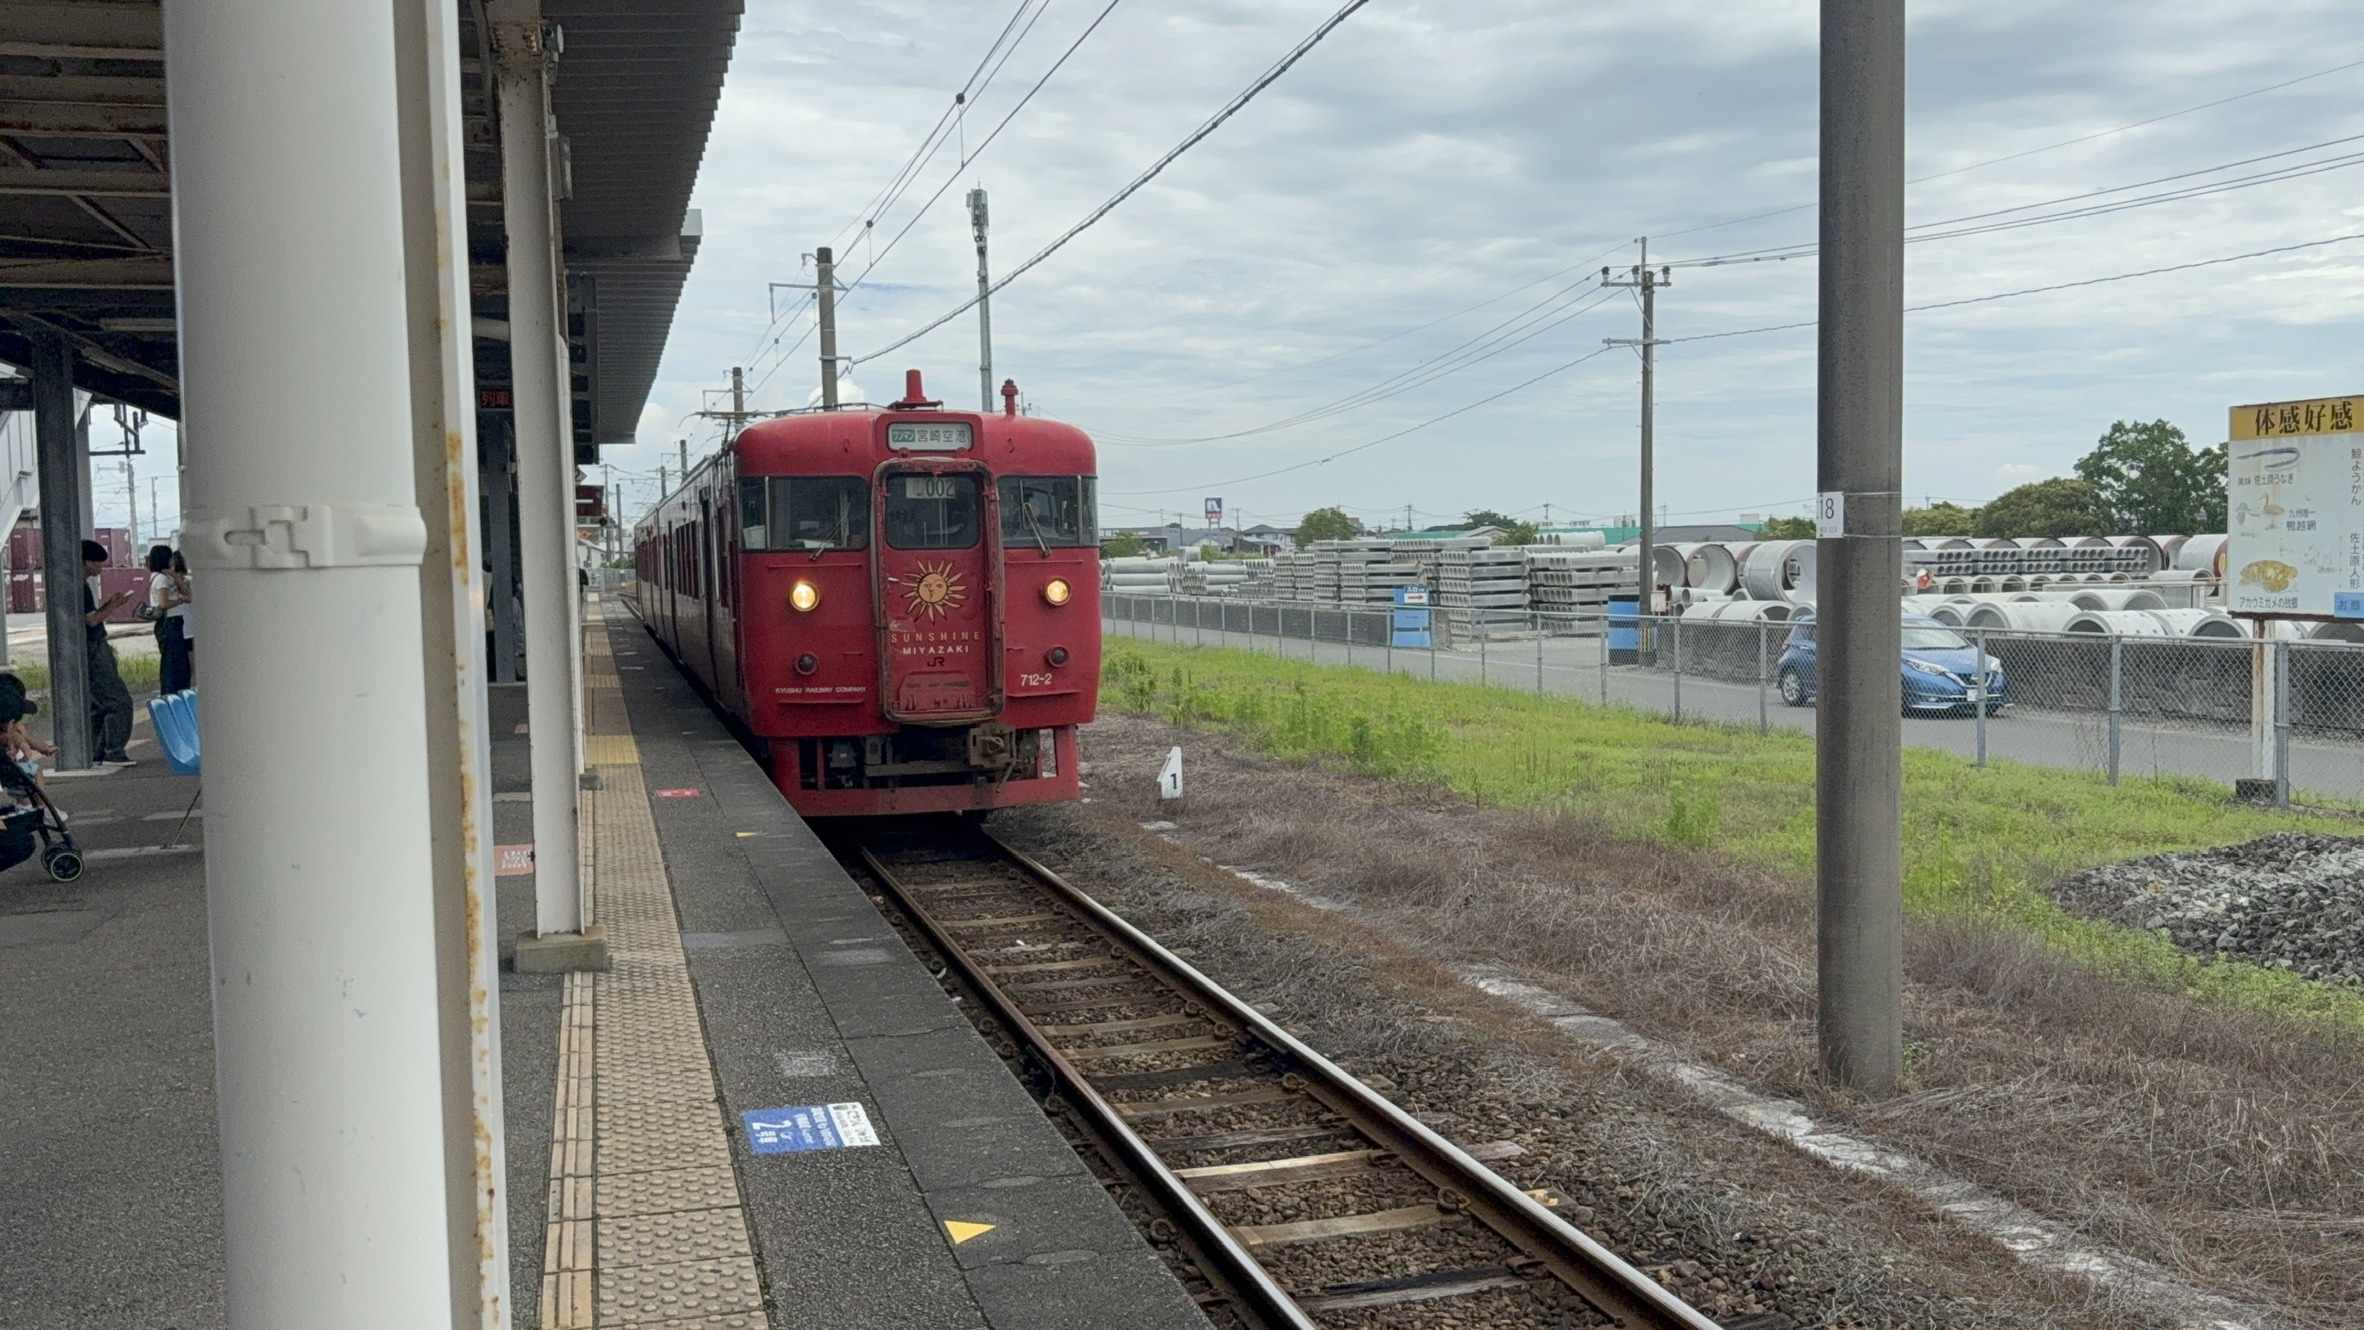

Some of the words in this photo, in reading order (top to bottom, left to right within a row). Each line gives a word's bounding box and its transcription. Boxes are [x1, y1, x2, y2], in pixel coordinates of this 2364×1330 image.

[2255, 401, 2353, 436] 体感好感
[892, 430, 914, 441] ワンマン
[917, 429, 967, 443] 宮崎空港
[2254, 473, 2294, 486] 佐土原うなぎ
[2351, 448, 2362, 506] 鯨ようかん
[926, 478, 956, 497] 002
[2288, 508, 2316, 518] 九州唯一
[2286, 520, 2316, 532] 鴨越網
[2349, 532, 2361, 590] 佐土原人形
[2239, 596, 2298, 609] アカウミガメの故郷
[891, 631, 980, 643] SUNSHINE
[902, 645, 969, 655] MIYAZAKI
[926, 656, 946, 668] JR
[1020, 672, 1053, 687] 712-2
[1169, 772, 1178, 790] 1
